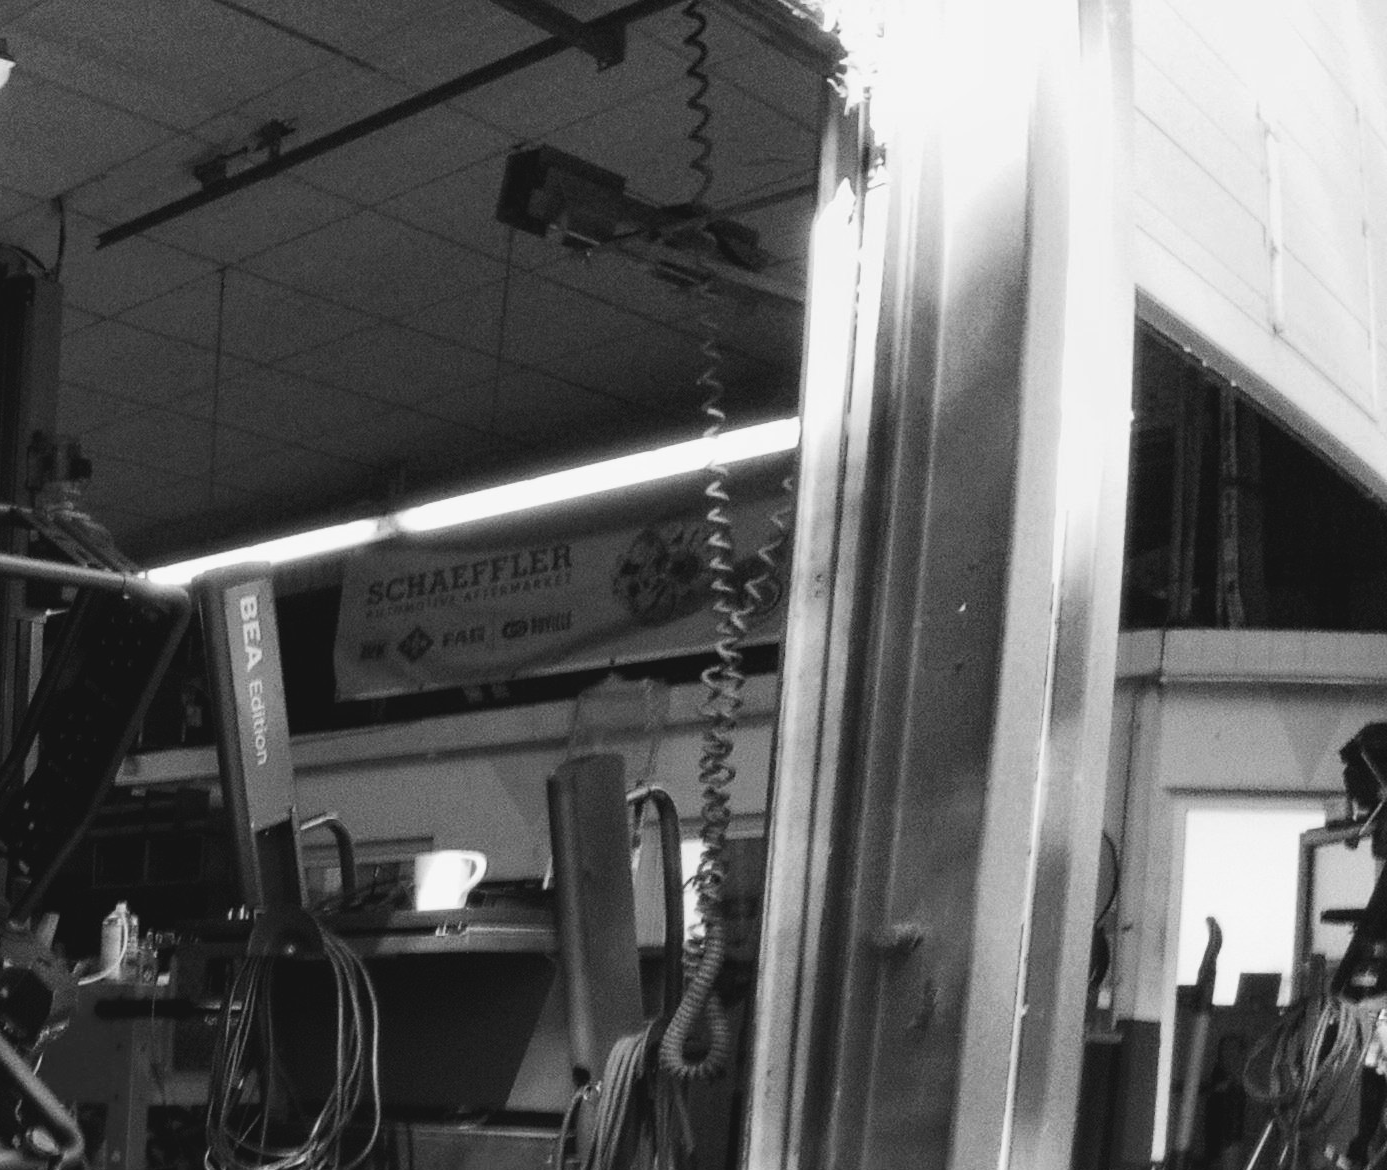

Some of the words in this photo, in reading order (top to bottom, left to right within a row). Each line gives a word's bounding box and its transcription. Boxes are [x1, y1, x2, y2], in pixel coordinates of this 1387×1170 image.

[366, 544, 573, 606] SCHAEFFLER
[463, 572, 572, 602] AFTERMARKET
[239, 595, 263, 673] BEA
[249, 679, 269, 767] Edition
